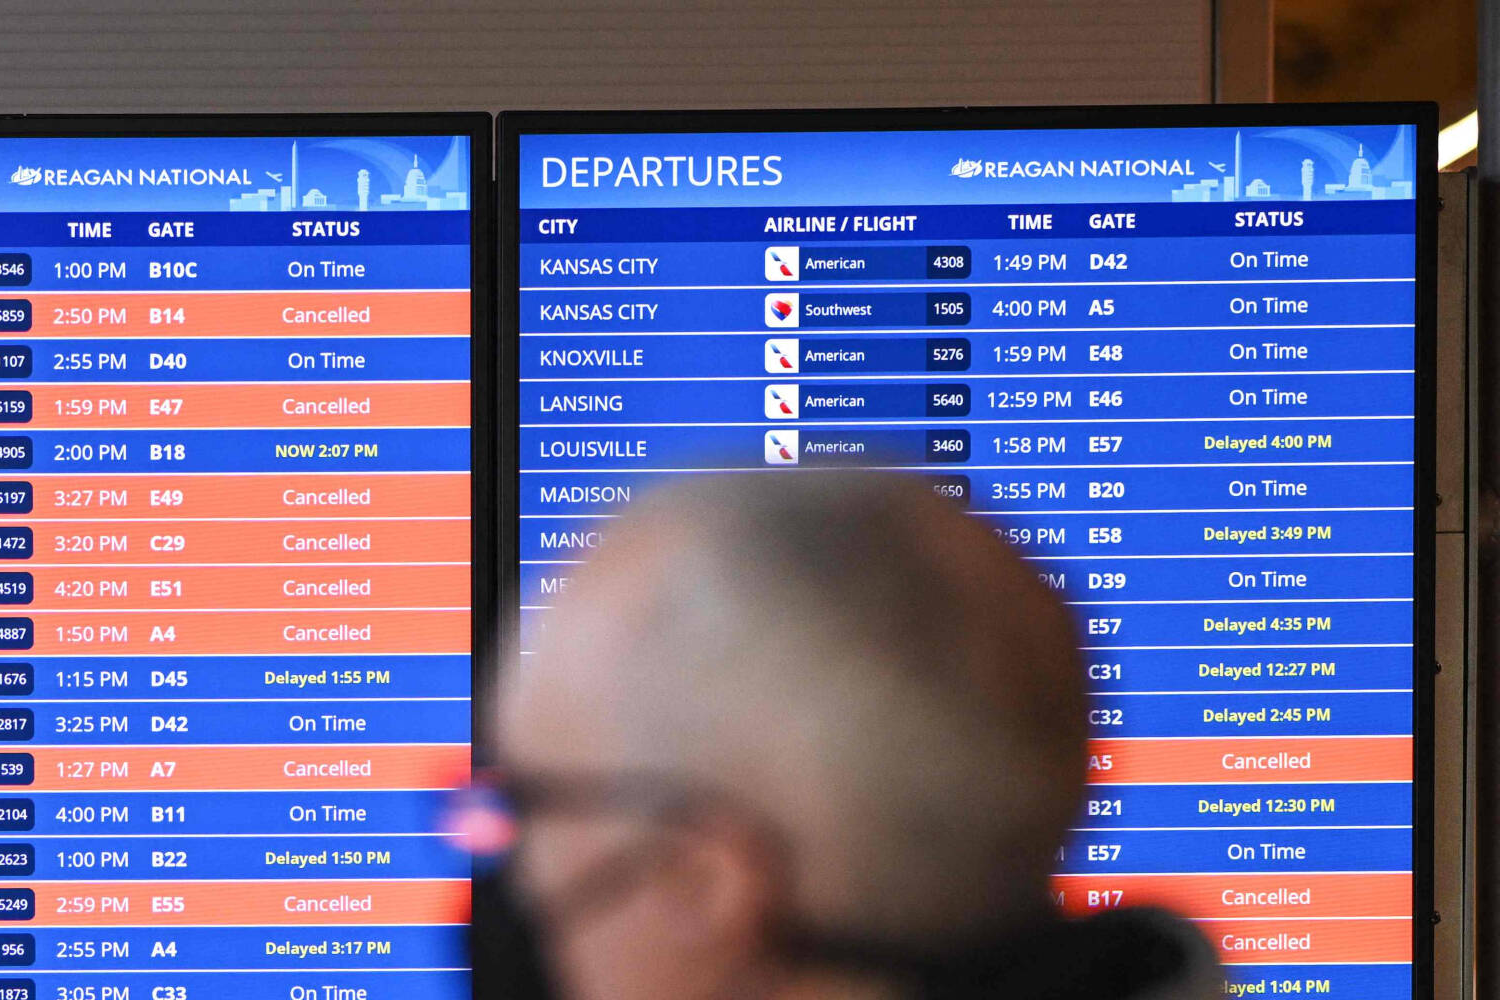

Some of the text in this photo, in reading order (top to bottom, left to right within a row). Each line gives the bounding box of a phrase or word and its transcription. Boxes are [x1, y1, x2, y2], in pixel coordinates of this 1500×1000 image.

[44, 168, 252, 186] REAGAN NATIONAL
[542, 155, 783, 188] DEPARTURES
[984, 159, 1195, 178] REAGAN NATIONAL
[538, 218, 579, 235] CITY
[763, 215, 918, 233] AIRLINE / FLIGHT
[1007, 213, 1053, 230] TIME
[1088, 213, 1136, 229] GATE
[1234, 211, 1304, 228] STATUS
[67, 222, 112, 238] TIME
[147, 221, 194, 238] GATE
[292, 221, 360, 237] STATUS
[54, 261, 126, 279] 1:00 PM
[149, 261, 198, 279] B10C
[287, 260, 366, 278] On Time
[540, 349, 644, 366] KNOXVILLE
[804, 349, 865, 362] American
[933, 348, 964, 361] 5276
[993, 345, 1066, 363] 1:59 PM
[1089, 344, 1123, 362] E48
[1229, 342, 1308, 360] On Time
[54, 399, 127, 416] 1:59 PM
[149, 398, 184, 416] E47
[282, 397, 371, 415] Cancelled
[540, 440, 647, 458] LOUISVILLE
[804, 440, 865, 454] American
[932, 439, 964, 452] 3460
[993, 436, 1066, 454] 1:58 PM
[1088, 435, 1123, 453] E57
[1204, 434, 1332, 454] Delayed 4:00 PM
[1088, 663, 1121, 680] C31
[1198, 662, 1336, 681] Delayed 12:27 PM
[1221, 752, 1311, 770] Cancelled
[1, 943, 25, 956] 956
[56, 941, 129, 958] 2:55 PM
[150, 941, 178, 958] A4
[265, 940, 391, 959] Delayed 3:17 PM
